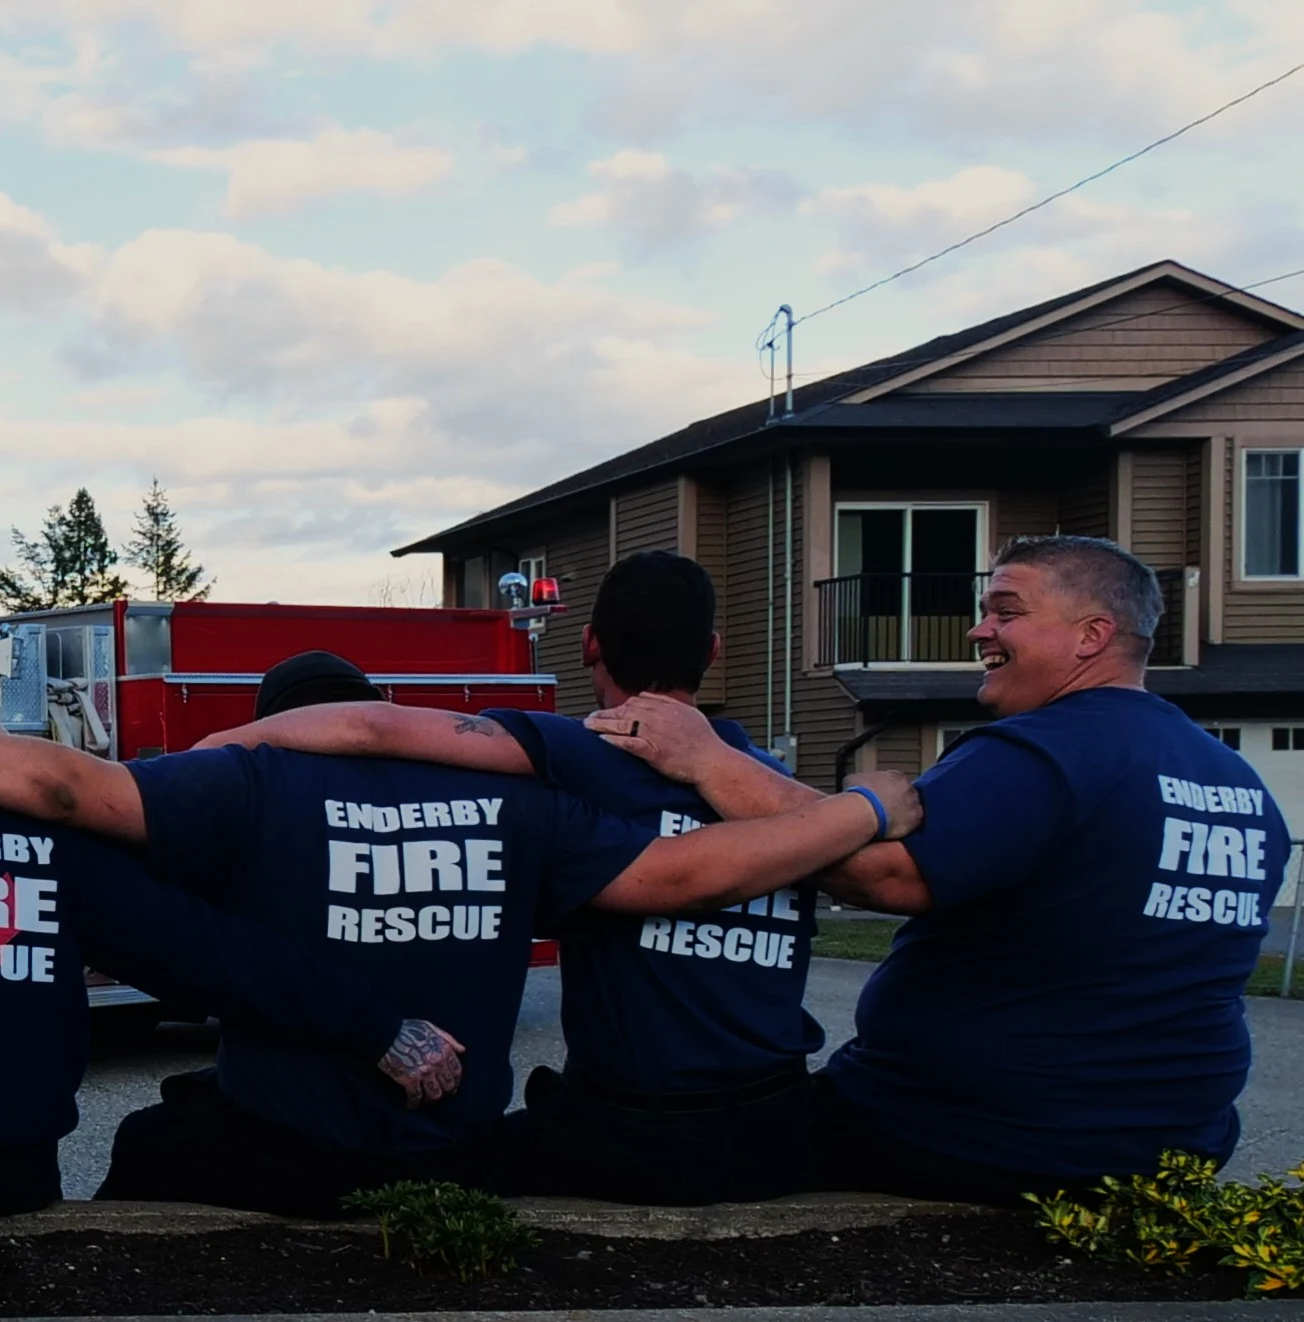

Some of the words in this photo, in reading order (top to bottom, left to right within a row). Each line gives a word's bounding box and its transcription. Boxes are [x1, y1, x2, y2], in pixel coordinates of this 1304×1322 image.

[324, 798, 504, 833] ENDERBY
[1157, 774, 1264, 816] ENDERBY
[328, 838, 507, 896] FIRE
[1158, 816, 1267, 880] FIRE
[326, 904, 503, 943] RESCUE
[1143, 881, 1262, 927] RESCUE
[639, 916, 796, 969] RESCUE
